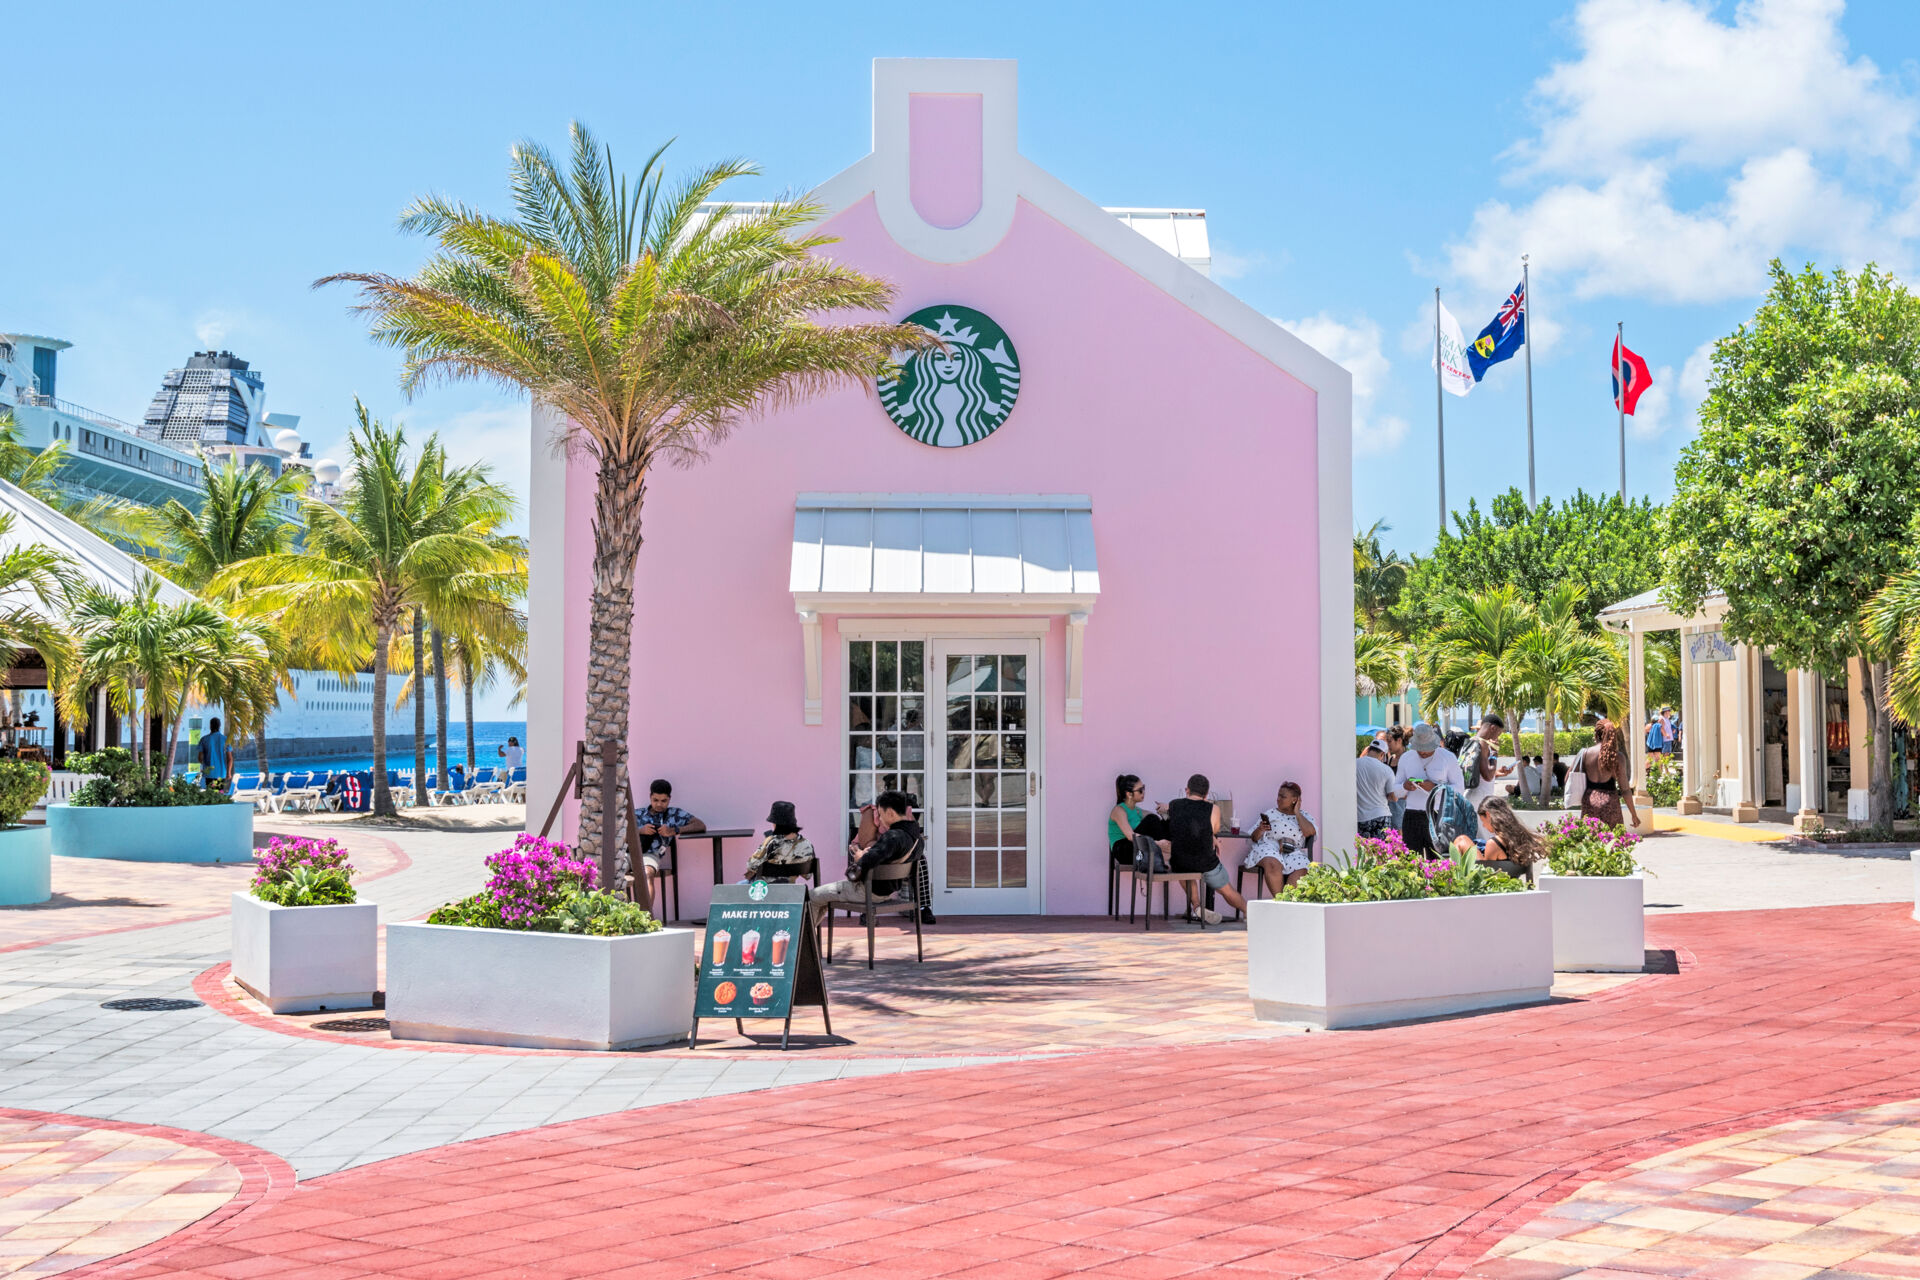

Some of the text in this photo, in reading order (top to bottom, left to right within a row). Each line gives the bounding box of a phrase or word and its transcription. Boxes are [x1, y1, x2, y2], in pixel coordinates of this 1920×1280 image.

[1440, 330, 1467, 357] GRAN
[1447, 365, 1471, 379] CENTER
[722, 911, 789, 919] MAKE IT YOURS
